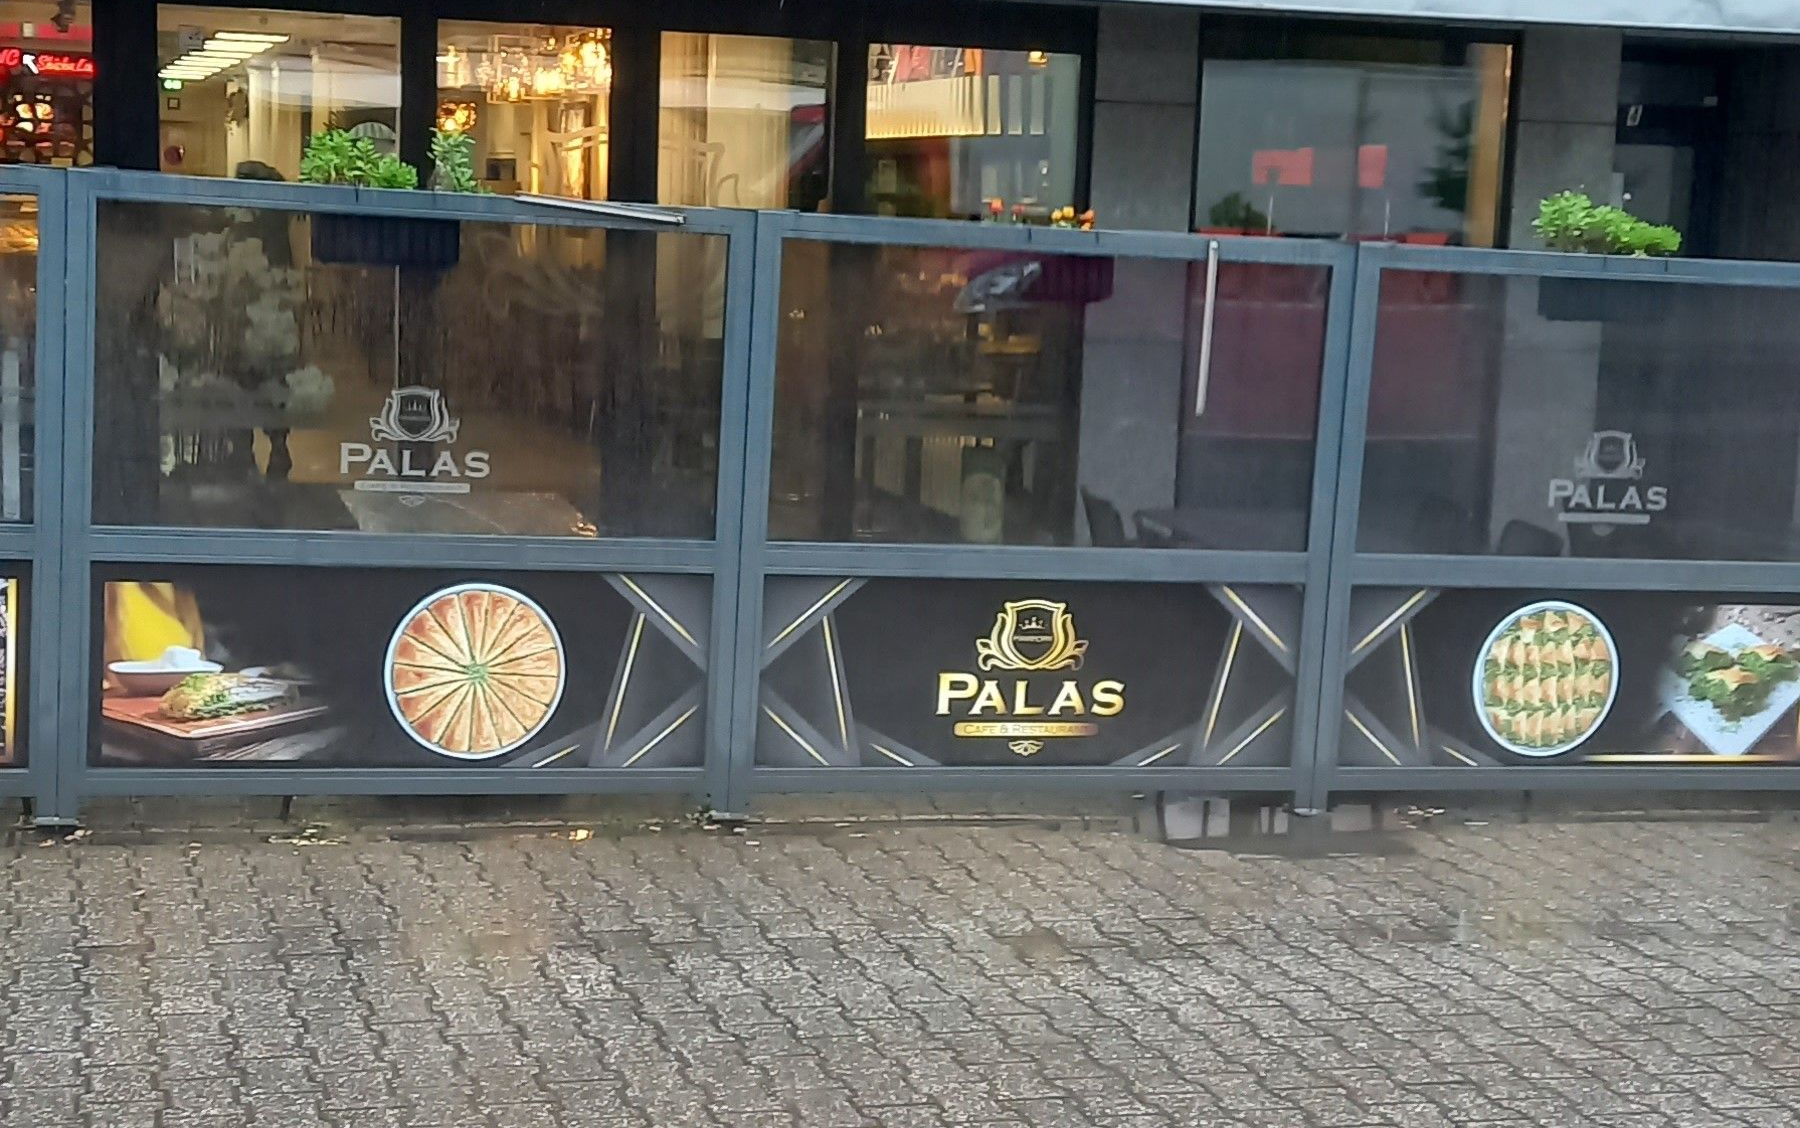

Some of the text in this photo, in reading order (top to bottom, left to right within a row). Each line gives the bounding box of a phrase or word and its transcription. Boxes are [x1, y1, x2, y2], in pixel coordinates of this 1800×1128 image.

[340, 442, 491, 478] PALAS
[1548, 478, 1668, 511] PALAS
[935, 672, 1126, 716] PALAS
